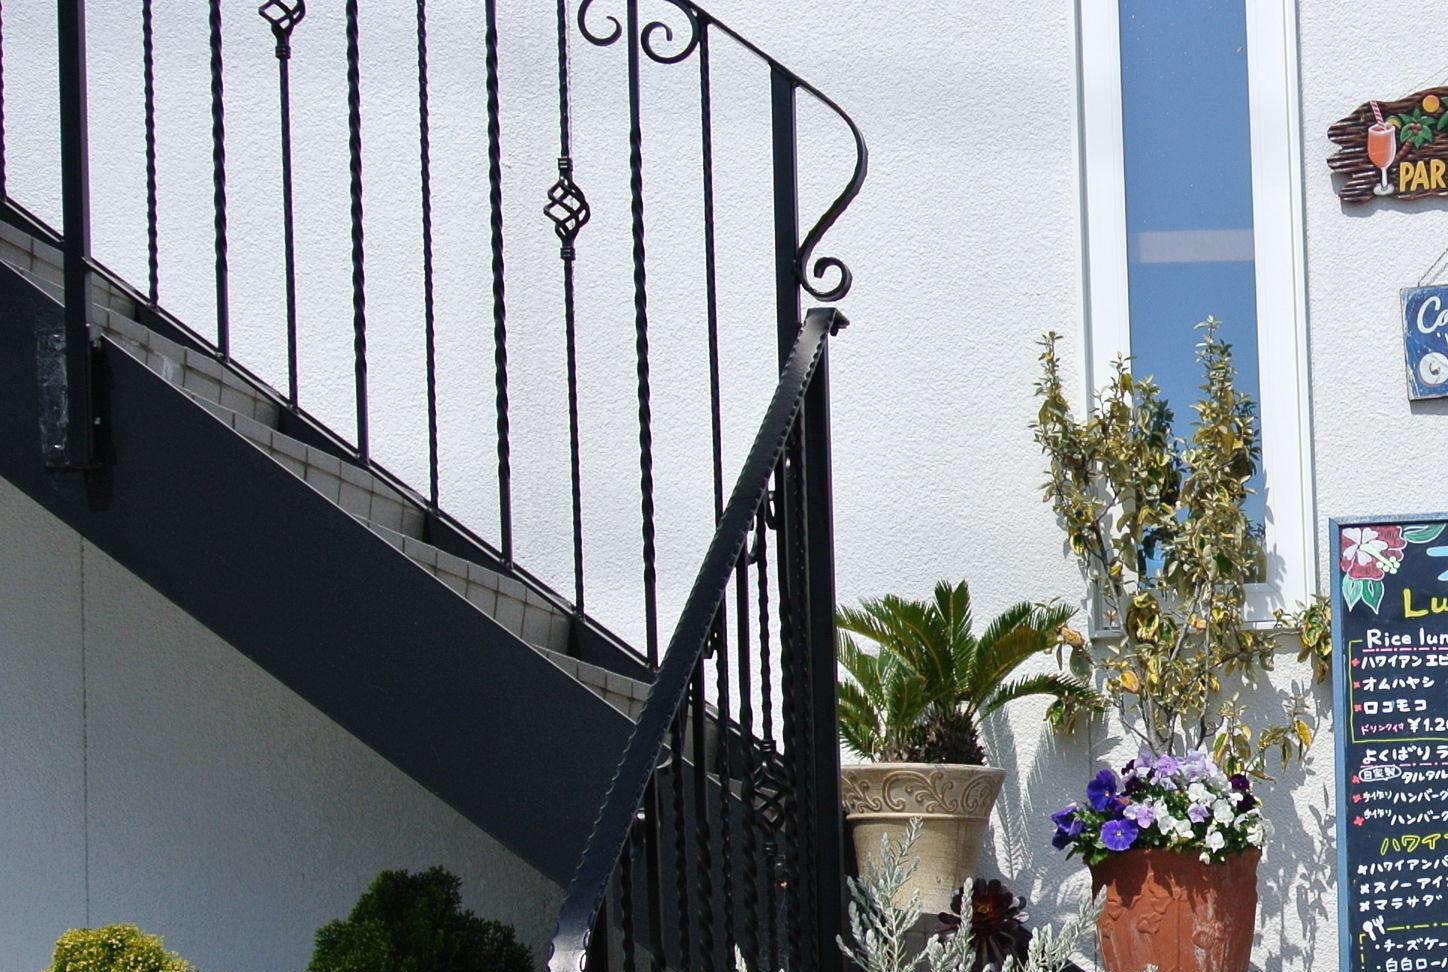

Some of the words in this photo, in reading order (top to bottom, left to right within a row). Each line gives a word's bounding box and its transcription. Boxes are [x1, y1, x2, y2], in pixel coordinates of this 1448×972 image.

[1366, 628, 1412, 649] Rice
[1362, 676, 1435, 692] オムハヤシ
[1363, 699, 1427, 715] ロコモコ
[1374, 894, 1443, 911] マラサダ
